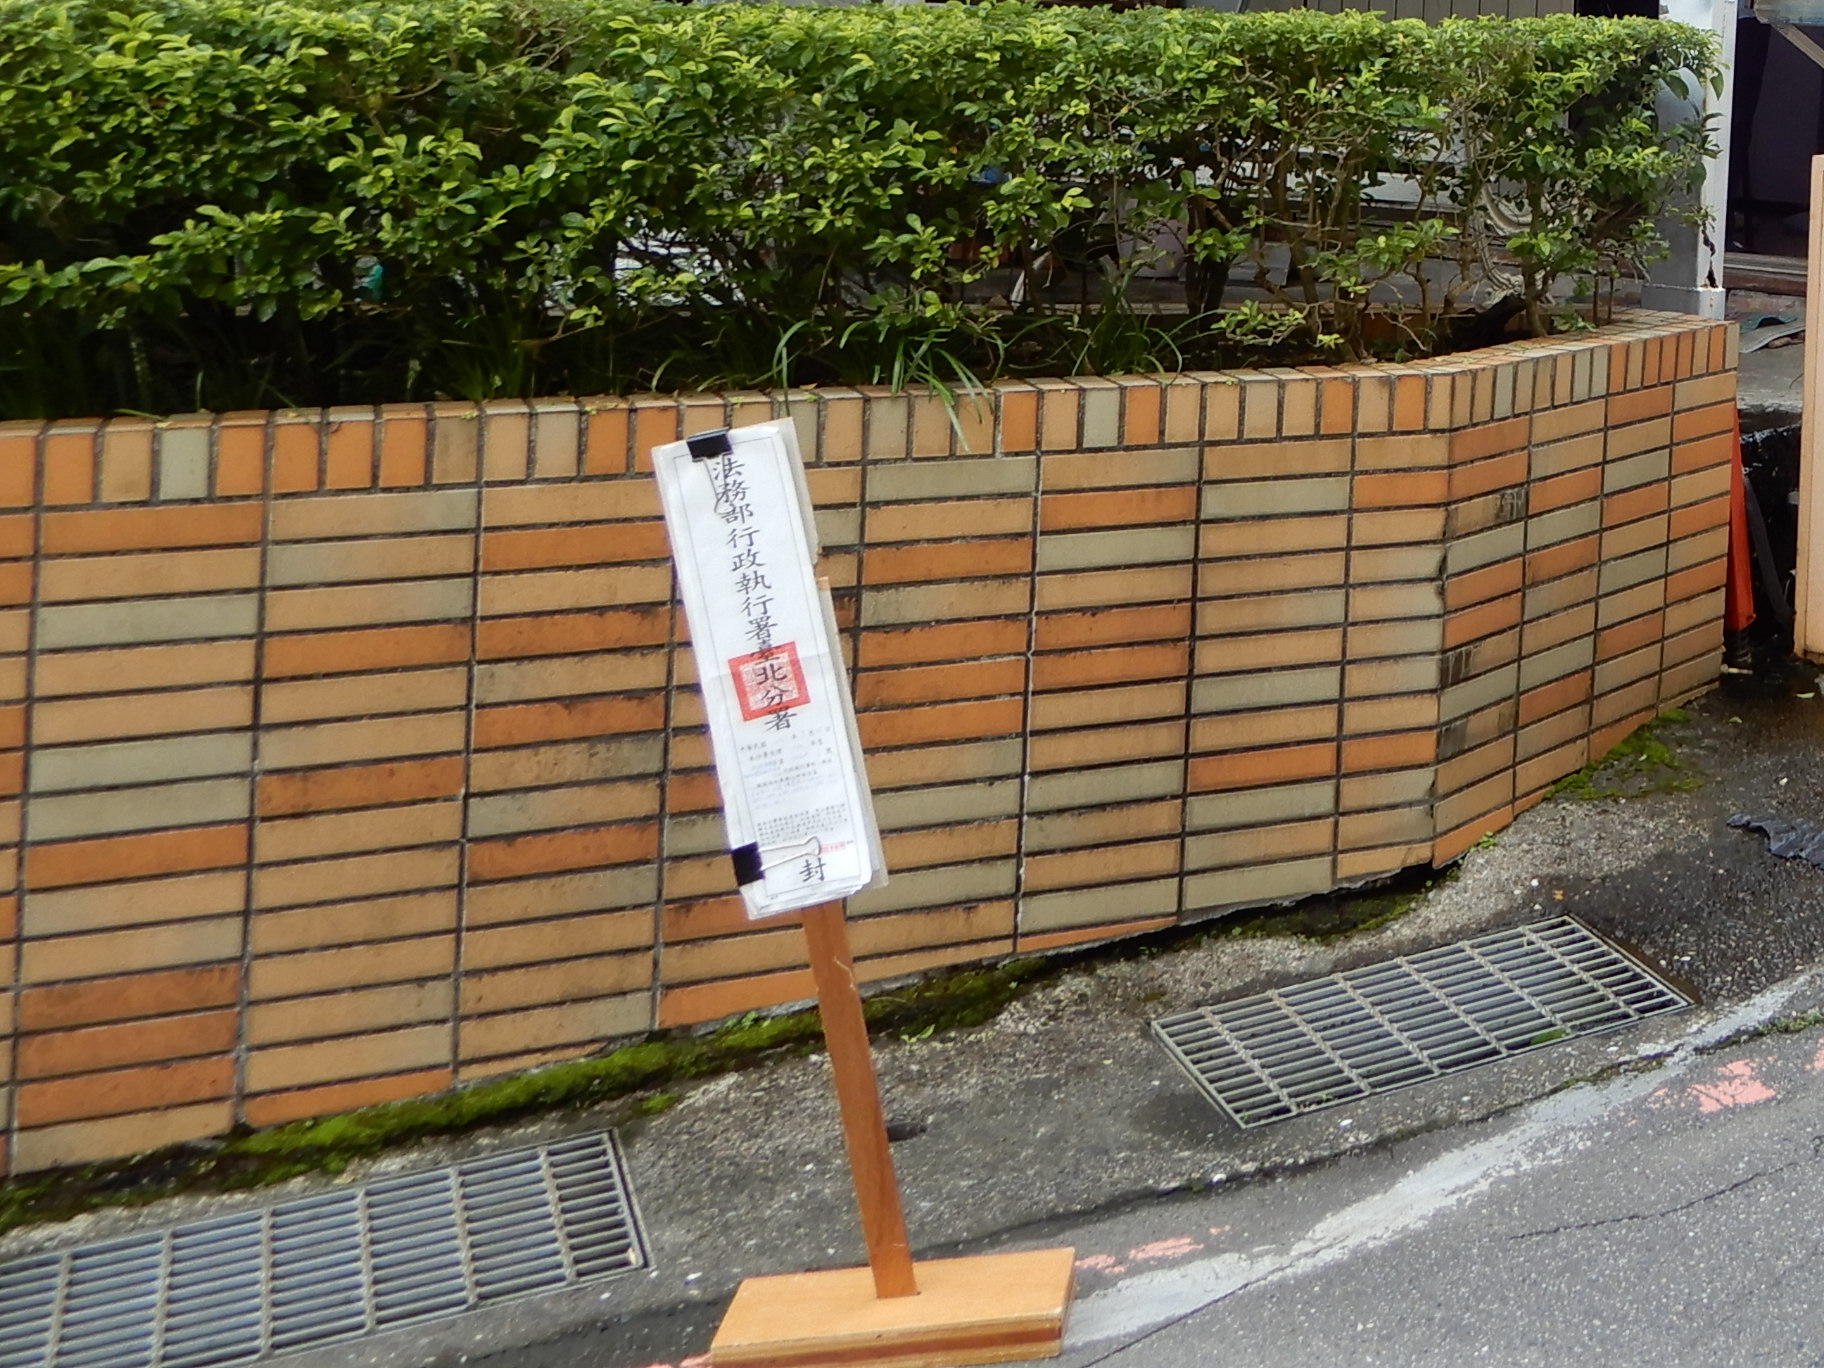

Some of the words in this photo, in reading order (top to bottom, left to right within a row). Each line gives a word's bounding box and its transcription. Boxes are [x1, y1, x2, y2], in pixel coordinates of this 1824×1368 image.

[713, 457, 798, 732] 法務部行政執行署臺北分署
[799, 856, 827, 883] 封
